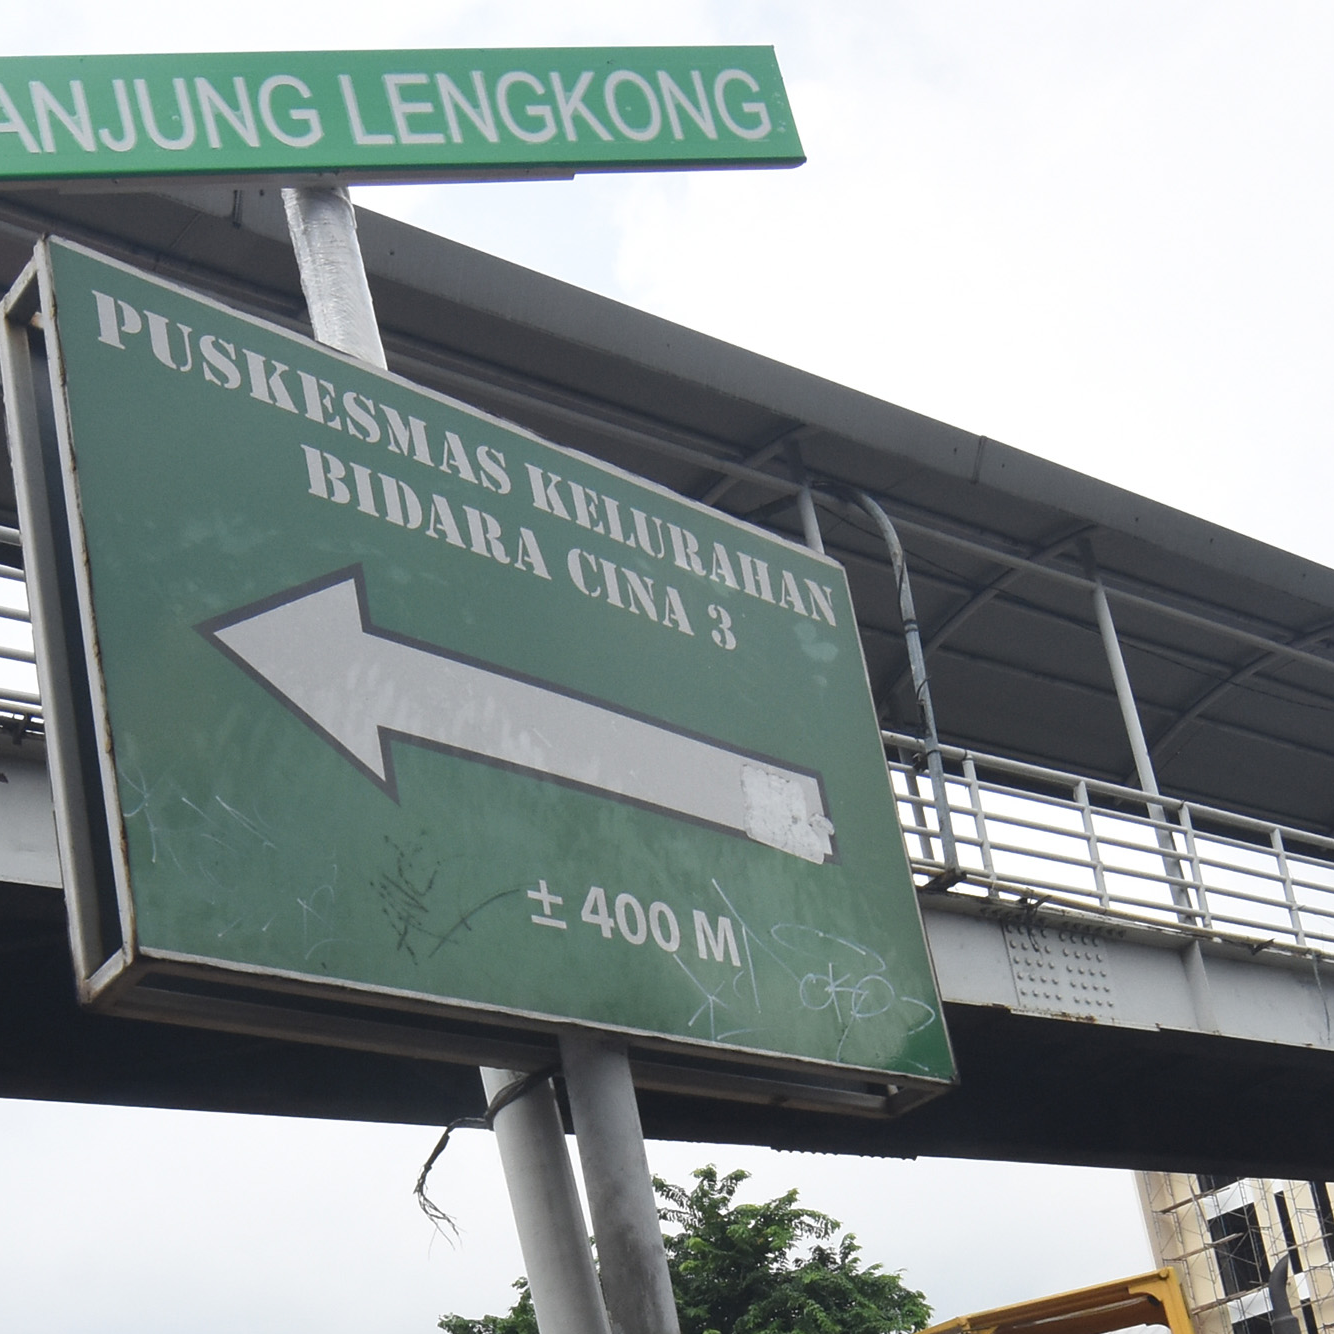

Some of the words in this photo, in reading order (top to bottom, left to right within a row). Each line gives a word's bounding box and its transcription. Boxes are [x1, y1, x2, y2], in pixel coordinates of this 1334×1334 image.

[338, 66, 773, 147] LENGKONG
[91, 287, 512, 497] PUSKESMAS
[523, 460, 838, 628] KELURAHAN
[300, 444, 553, 580] BIDARA
[566, 546, 695, 638] CINA
[708, 604, 738, 652] 3
[526, 878, 568, 932] ±
[581, 886, 681, 954] 400
[695, 908, 741, 968] M
